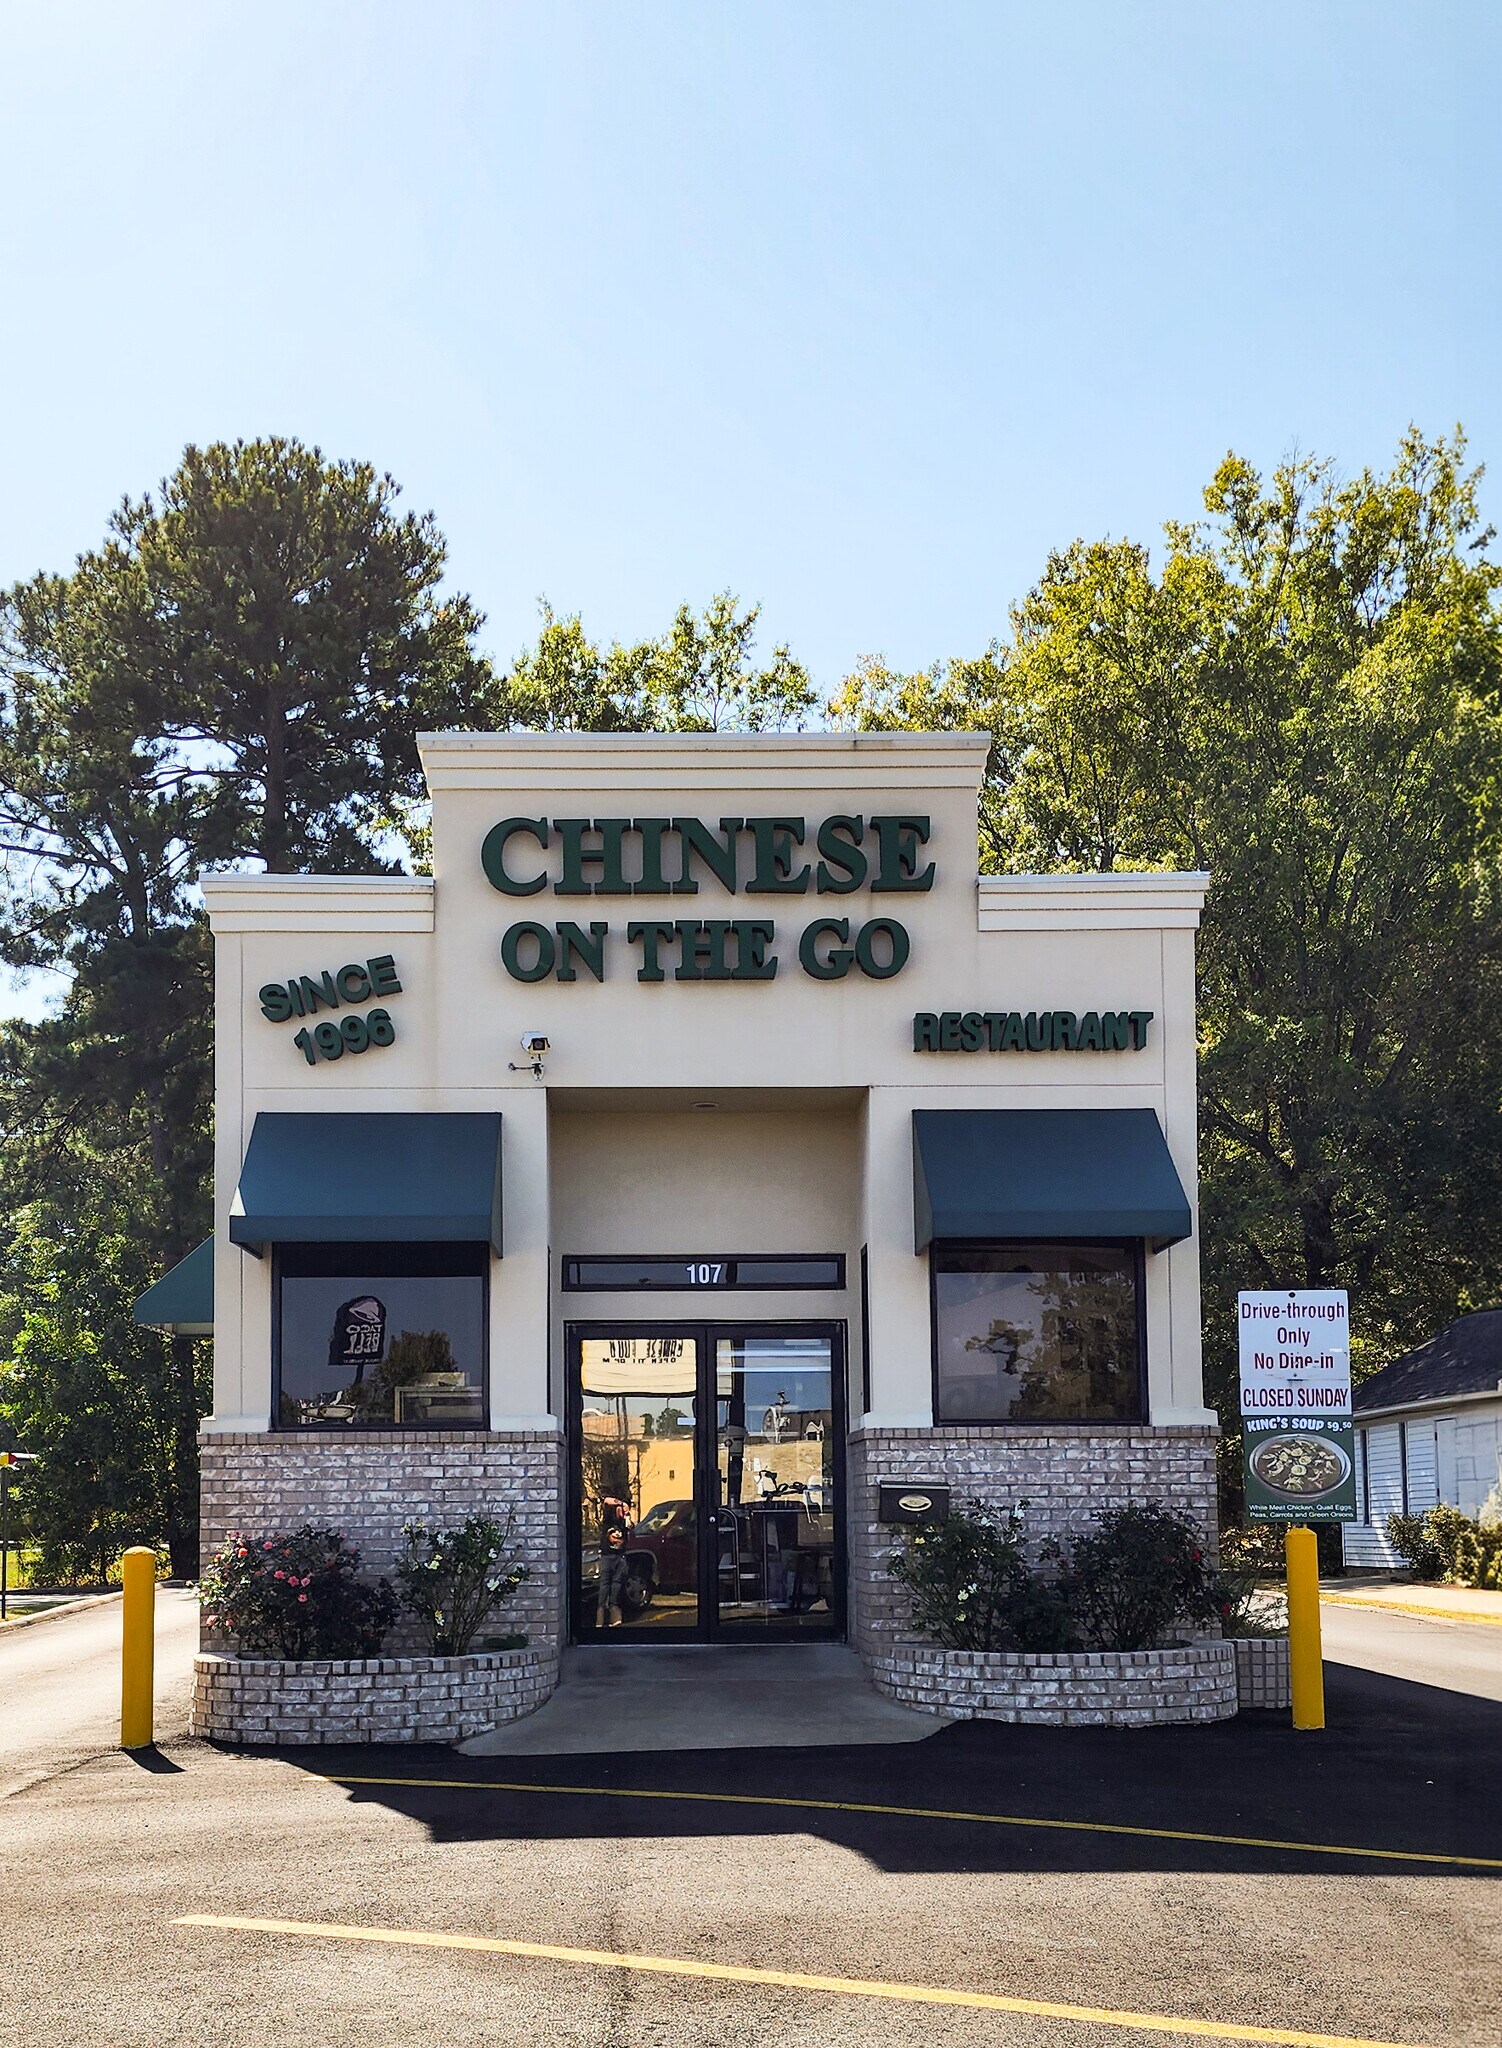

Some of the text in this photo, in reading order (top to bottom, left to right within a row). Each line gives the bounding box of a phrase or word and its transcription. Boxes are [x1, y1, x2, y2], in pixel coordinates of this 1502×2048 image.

[481, 814, 936, 897] CHINESE
[501, 917, 910, 982] ON THE GO
[259, 954, 403, 1023] SINCE
[293, 1008, 395, 1066] 1996
[913, 1011, 1154, 1052] RESTAURANT
[686, 1263, 722, 1284] 107
[1241, 1302, 1345, 1321] Drive-through
[1277, 1327, 1310, 1347] Only
[1254, 1352, 1334, 1369] No Dine-in
[1243, 1388, 1348, 1407] CLOSED SUNDAY
[1246, 1416, 1289, 1432] KING'S
[1291, 1417, 1325, 1431] SOUP
